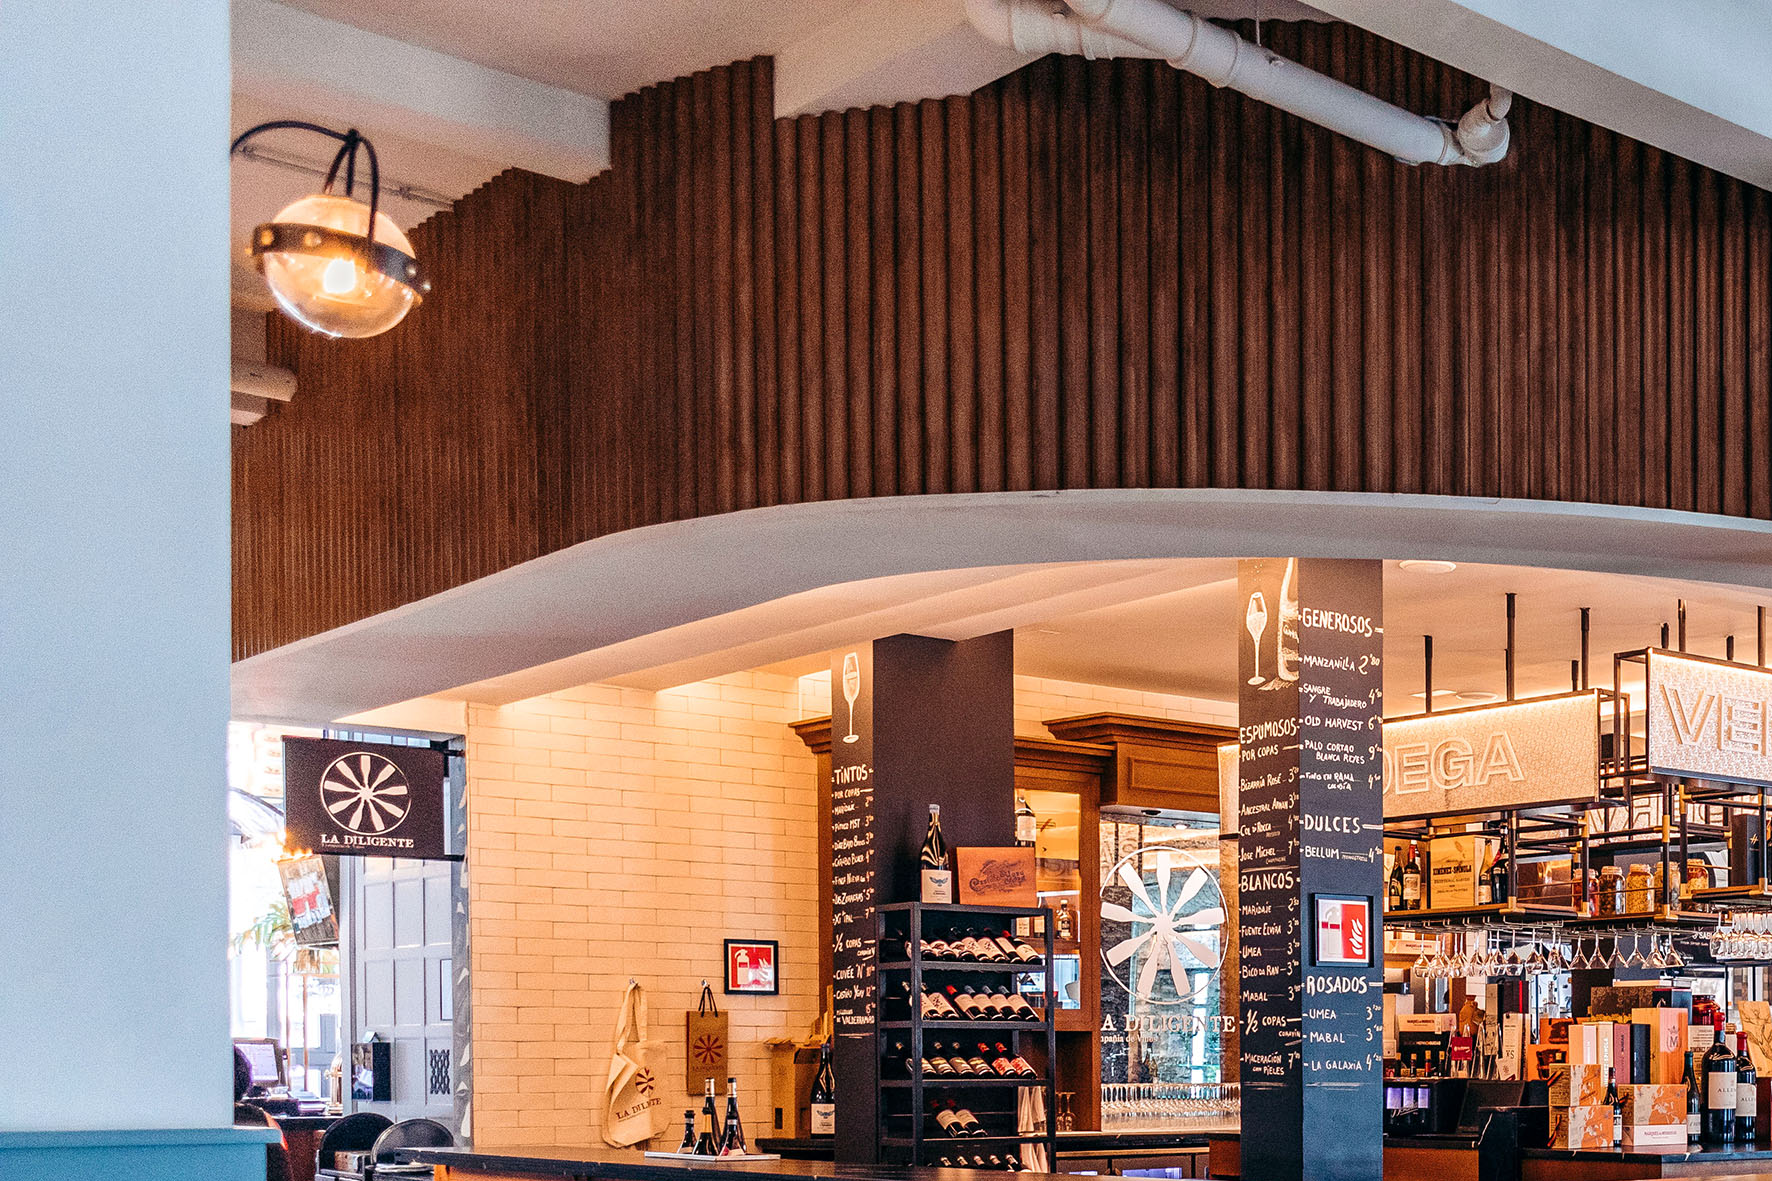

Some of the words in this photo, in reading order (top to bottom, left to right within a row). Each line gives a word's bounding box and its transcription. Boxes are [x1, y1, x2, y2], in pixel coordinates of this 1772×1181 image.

[1303, 608, 1373, 637] GENEROSOS
[1304, 654, 1355, 671] MANZANILLA
[1303, 683, 1331, 695] SANGRE
[1309, 694, 1317, 703] Y
[1323, 695, 1367, 709] TRABAJADERO
[1304, 715, 1321, 726] OLD
[1325, 718, 1363, 731] HARVEST
[1240, 718, 1296, 744] ESPUMOSOS
[1304, 740, 1323, 751] PALO
[1242, 749, 1255, 762] POR
[1258, 745, 1278, 758] COPAS
[1316, 751, 1341, 762] BLANCA
[1343, 754, 1365, 764] REYES
[834, 764, 868, 785] TINTOS
[1304, 814, 1360, 834] DULCES
[321, 834, 339, 844] LA
[344, 835, 414, 849] DILIGENTE
[1305, 845, 1340, 860] BELLUM
[1241, 870, 1294, 892] BLANCOS
[1242, 901, 1272, 916] MARIDAJE
[1242, 926, 1262, 938] FUENTE
[1242, 945, 1262, 958] UMEA
[1306, 976, 1368, 996] ROSADOS
[1242, 990, 1268, 1002] MABAL
[1262, 1016, 1286, 1027] COPAS
[1309, 1008, 1336, 1020] UMEA
[1100, 1014, 1117, 1032] A
[1124, 1014, 1236, 1032] DILIGENTE
[1310, 1032, 1345, 1044] MABAL
[1263, 1066, 1284, 1076] PIELES
[1312, 1060, 1322, 1071] LA
[1326, 1060, 1362, 1071] GALAXIA
[616, 1110, 630, 1120] LA
